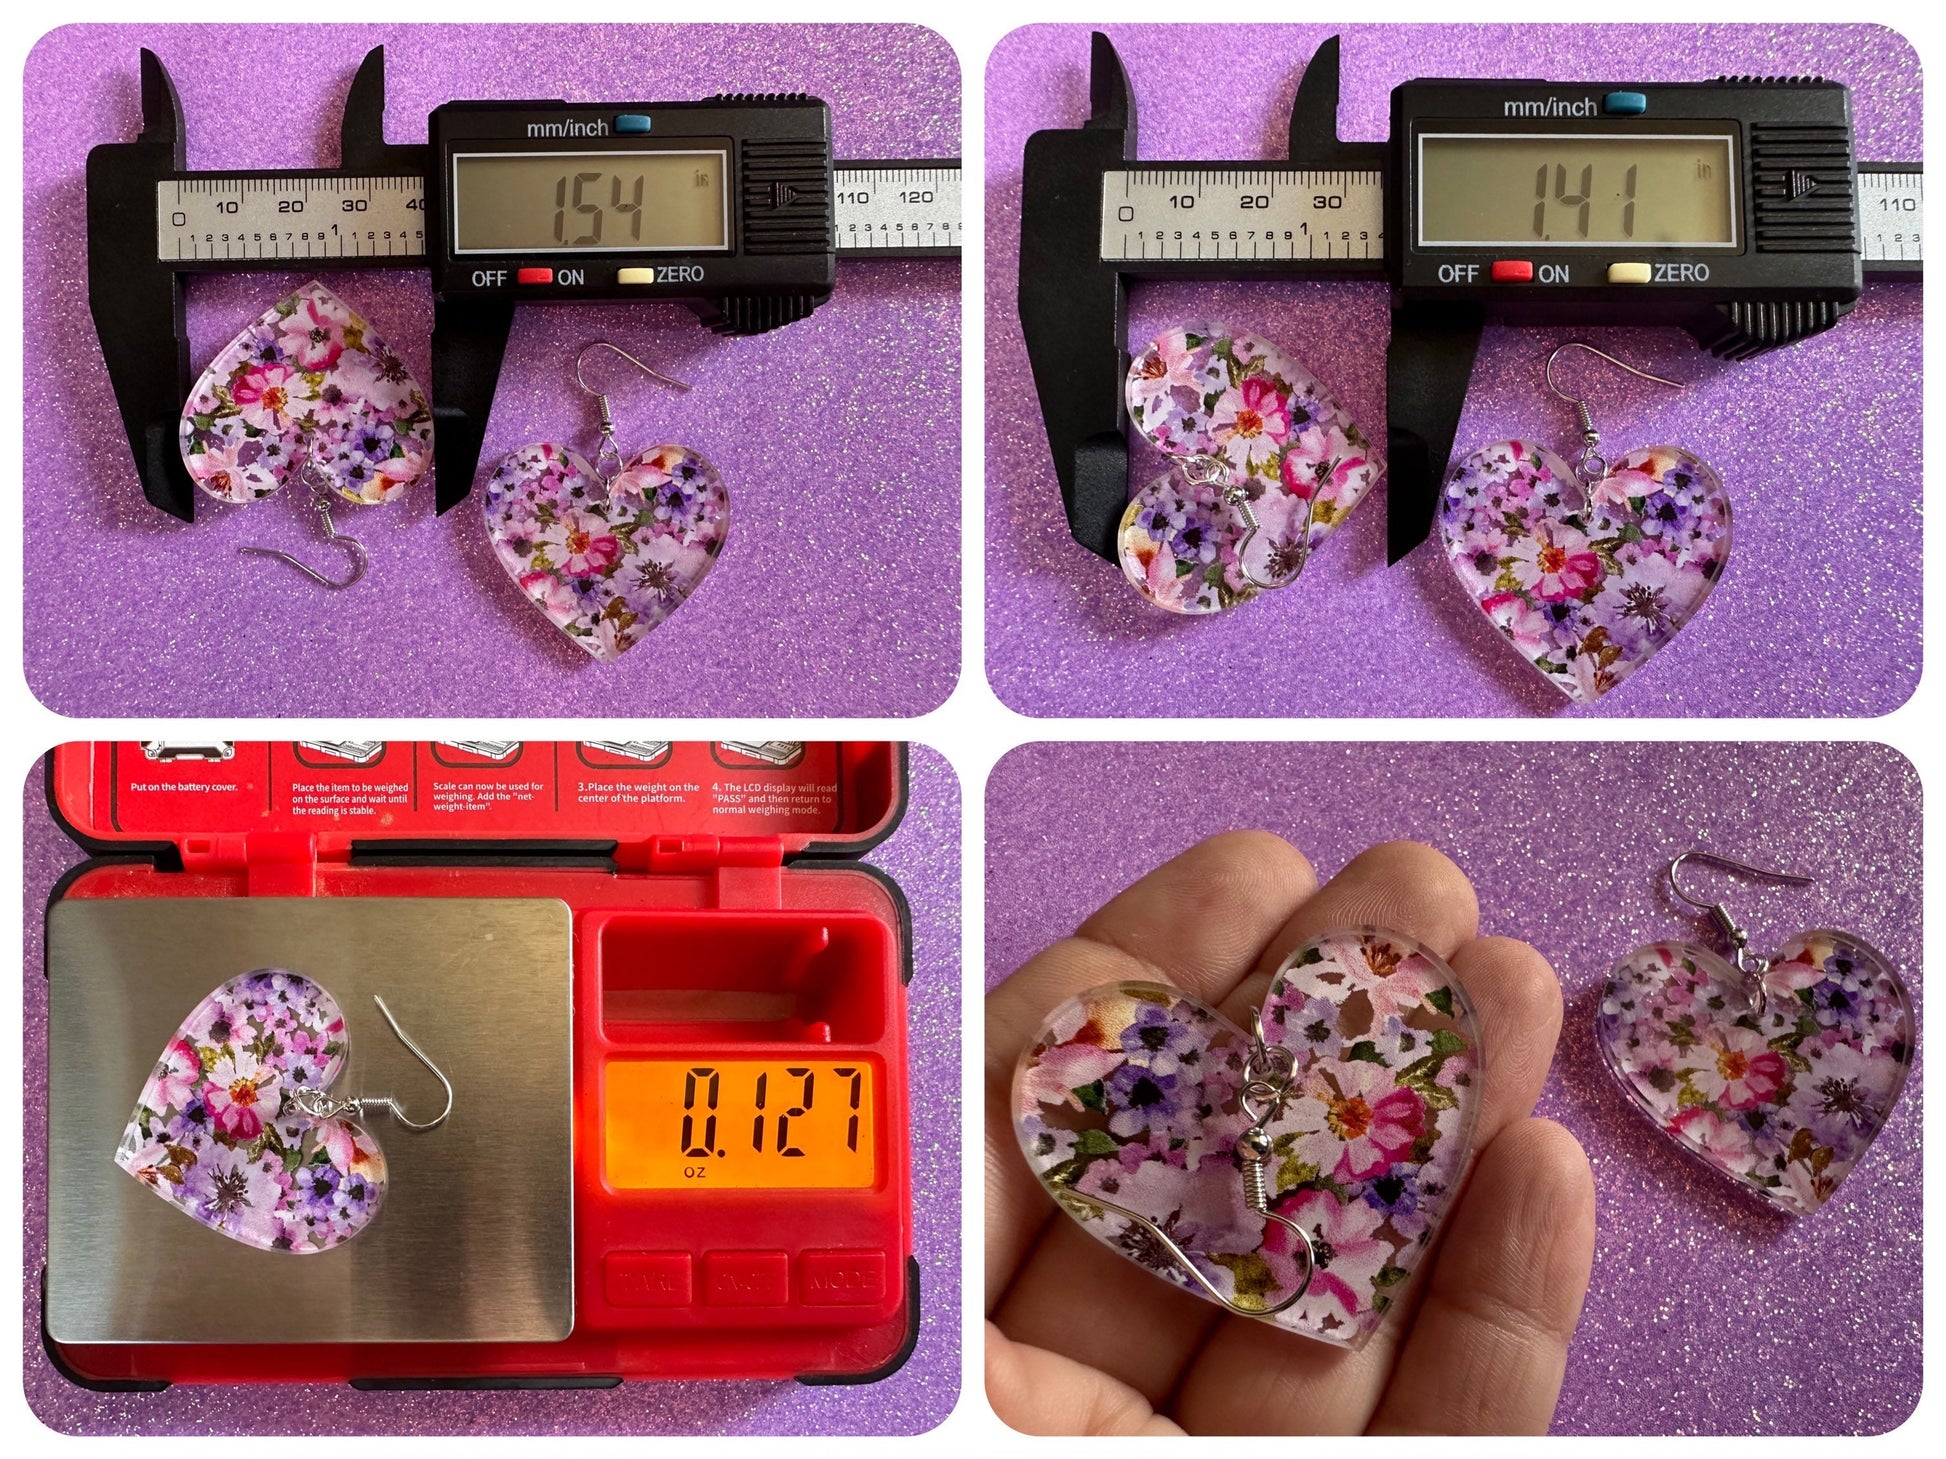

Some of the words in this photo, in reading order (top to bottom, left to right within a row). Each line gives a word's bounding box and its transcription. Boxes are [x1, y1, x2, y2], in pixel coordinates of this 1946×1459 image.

[1504, 97, 1597, 117] mm/inch
[527, 119, 608, 137] mm/inch
[1696, 158, 1711, 178] in
[694, 169, 709, 188] in
[837, 192, 869, 204] 110
[899, 191, 934, 203] 120
[1880, 198, 1916, 211] 110
[172, 212, 186, 227] 0
[216, 202, 239, 214] 10
[278, 201, 303, 213] 20
[342, 200, 367, 212] 30
[1118, 206, 1134, 222] 0
[1169, 195, 1195, 209] 10
[1240, 195, 1269, 209] 20
[1313, 195, 1342, 209] 30
[206, 234, 213, 242] 2
[270, 233, 277, 241] 6
[286, 233, 293, 241] 7
[302, 233, 309, 241] 8
[331, 224, 338, 236] 1
[384, 231, 391, 239] 3
[400, 231, 407, 239] 4
[880, 223, 888, 231] 4
[896, 223, 903, 231] 5
[1156, 232, 1164, 240] 2
[1174, 232, 1182, 240] 3
[1192, 232, 1200, 240] 4
[1211, 232, 1219, 240] 5
[1229, 232, 1237, 240] 6
[1247, 232, 1255, 240] 7
[1265, 232, 1274, 240] 8
[1284, 232, 1292, 240] 9
[1300, 222, 1308, 235] 1
[1342, 232, 1350, 240] 2
[1360, 232, 1368, 240] 3
[1895, 234, 1902, 242] 2
[1913, 234, 1920, 242] 3
[472, 270, 507, 287] OFF
[558, 269, 584, 286] ON
[657, 266, 704, 283] ZERO
[1438, 265, 1480, 283] OFF
[1538, 265, 1570, 283] ON
[1654, 264, 1710, 282] ZERO
[131, 783, 147, 792] Put
[148, 784, 160, 792] on
[161, 783, 176, 792] the
[178, 783, 210, 793] battery
[212, 784, 238, 792] cover.
[292, 783, 314, 792] Place
[316, 783, 330, 792] the
[331, 783, 350, 792] item
[352, 784, 361, 792] to
[362, 783, 372, 792] be
[374, 783, 409, 794] weighed
[433, 782, 456, 791] Scale
[496, 782, 507, 791] be
[508, 782, 529, 791] used
[531, 782, 544, 791] for
[578, 782, 614, 792] 3.Place
[616, 782, 632, 792] the
[634, 782, 667, 793] weight
[669, 784, 681, 792] on
[684, 782, 700, 792] the
[712, 782, 722, 792] 4.
[724, 783, 741, 792] The
[743, 783, 761, 792] LCD
[763, 783, 796, 794] display
[798, 783, 815, 792] will
[816, 784, 838, 793] read
[305, 795, 319, 803] the
[320, 795, 350, 803] surface
[351, 795, 367, 803] and
[368, 795, 387, 803] wait
[388, 795, 408, 803] until
[433, 792, 475, 802] weighing.
[477, 792, 495, 801] Add
[496, 792, 511, 801] the
[578, 794, 609, 803] center
[610, 794, 621, 803] of
[622, 794, 639, 803] the
[641, 794, 686, 804] platform.
[712, 794, 746, 803] "PASS"
[748, 794, 766, 803] and
[768, 794, 789, 803] then
[791, 796, 820, 804] return
[822, 796, 832, 804] to
[292, 806, 306, 815] the
[308, 806, 339, 817] reading
[341, 806, 348, 815] is
[349, 806, 377, 815] stable.
[712, 805, 746, 814] normal
[748, 805, 790, 816] weighing
[792, 805, 821, 815] mode.
[680, 1067, 862, 1157] 0.127
[810, 1271, 877, 1289] MODE
